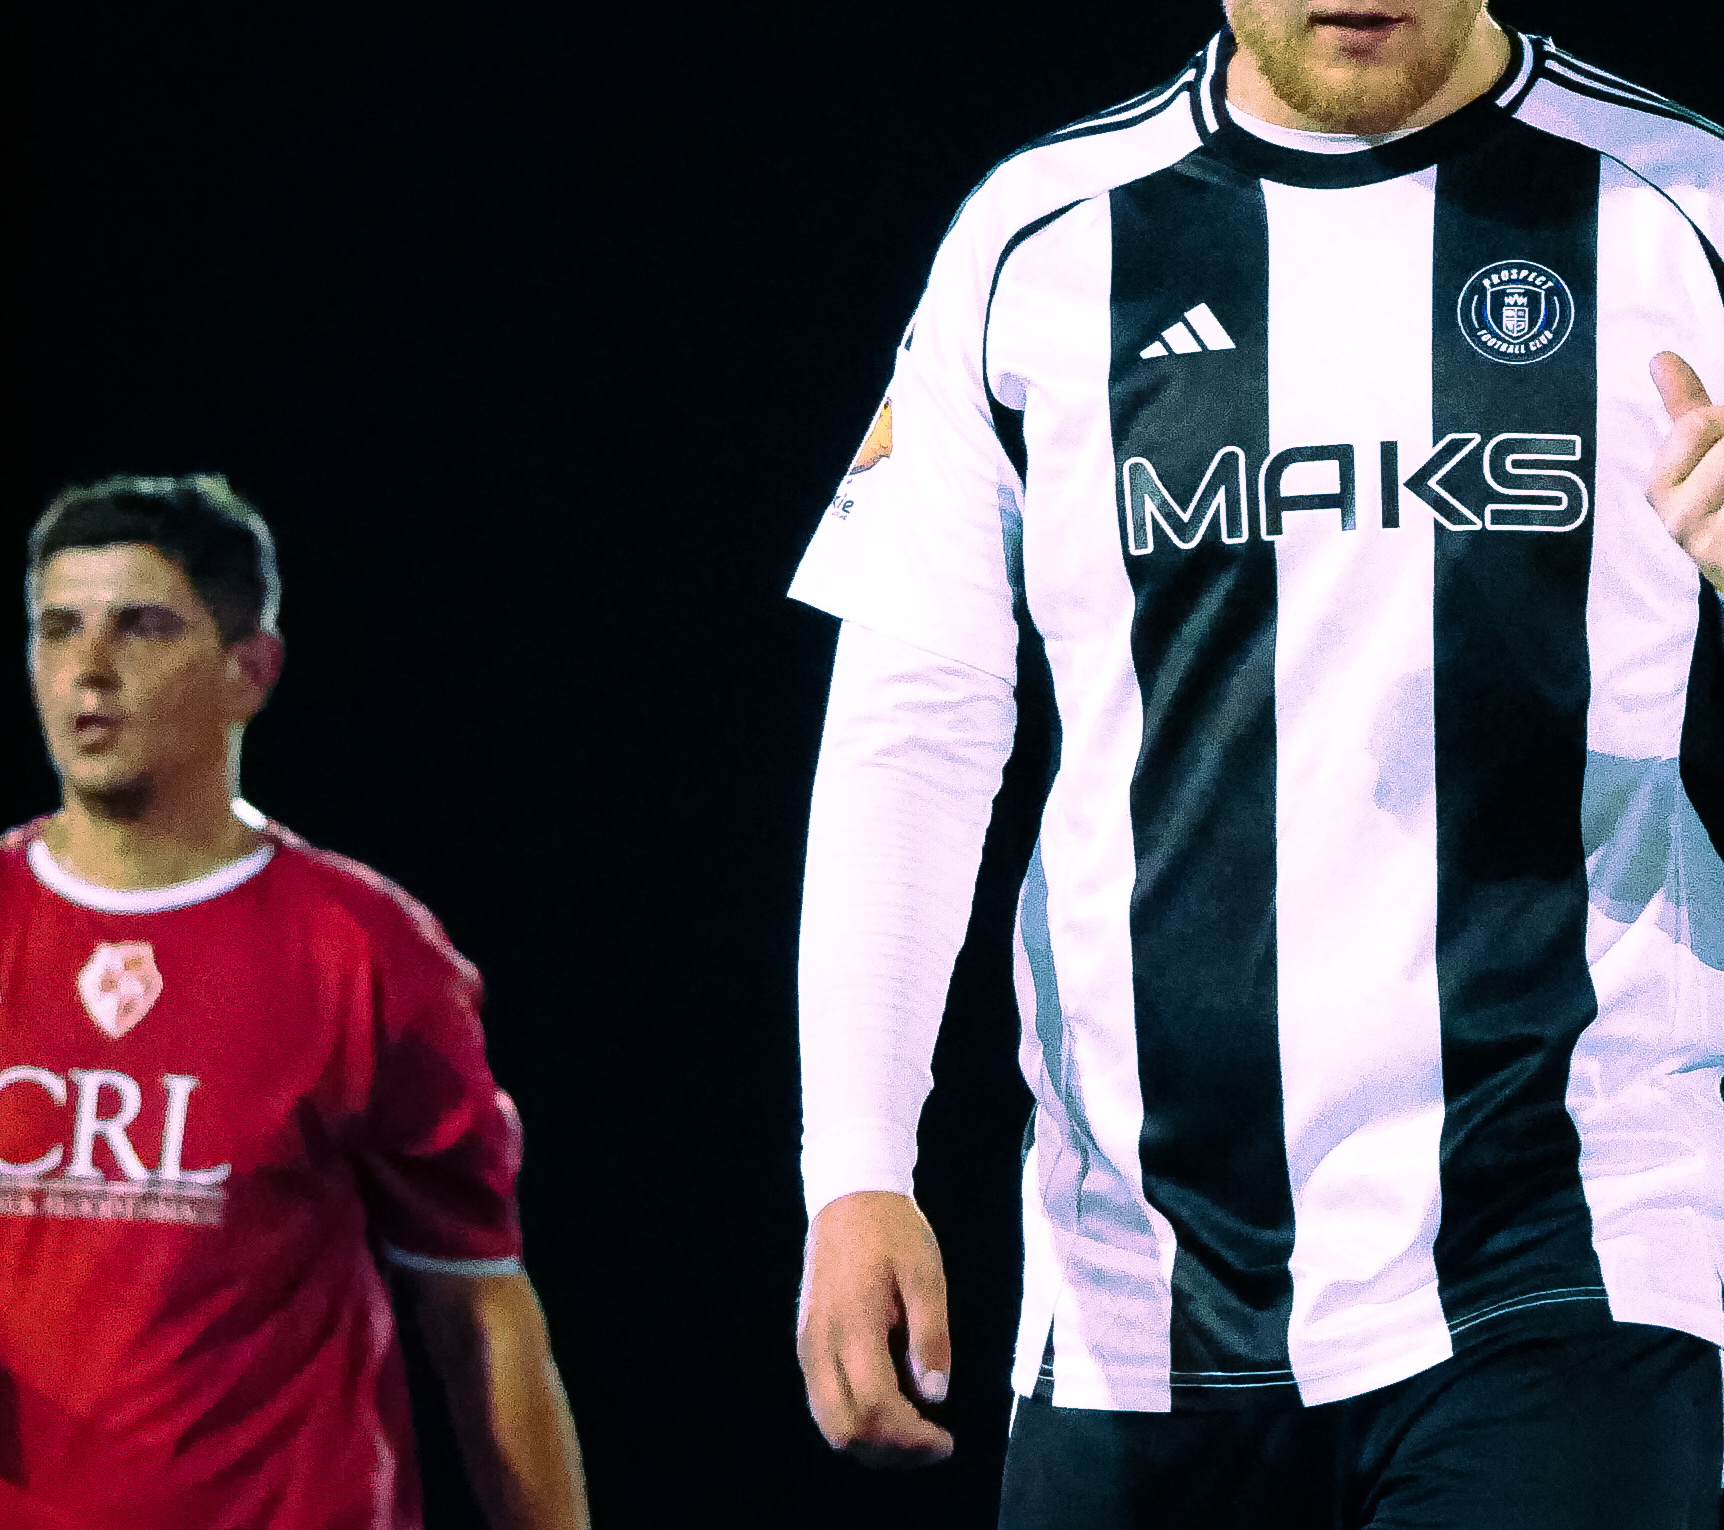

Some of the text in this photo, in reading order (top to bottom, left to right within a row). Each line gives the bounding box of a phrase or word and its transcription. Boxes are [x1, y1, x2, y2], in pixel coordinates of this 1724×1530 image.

[1482, 268, 1554, 289] PROSPECT
[1476, 329, 1554, 354] FOOTBALL CLUB
[1122, 432, 1590, 556] MAKS
[0, 1063, 232, 1186] CRL
